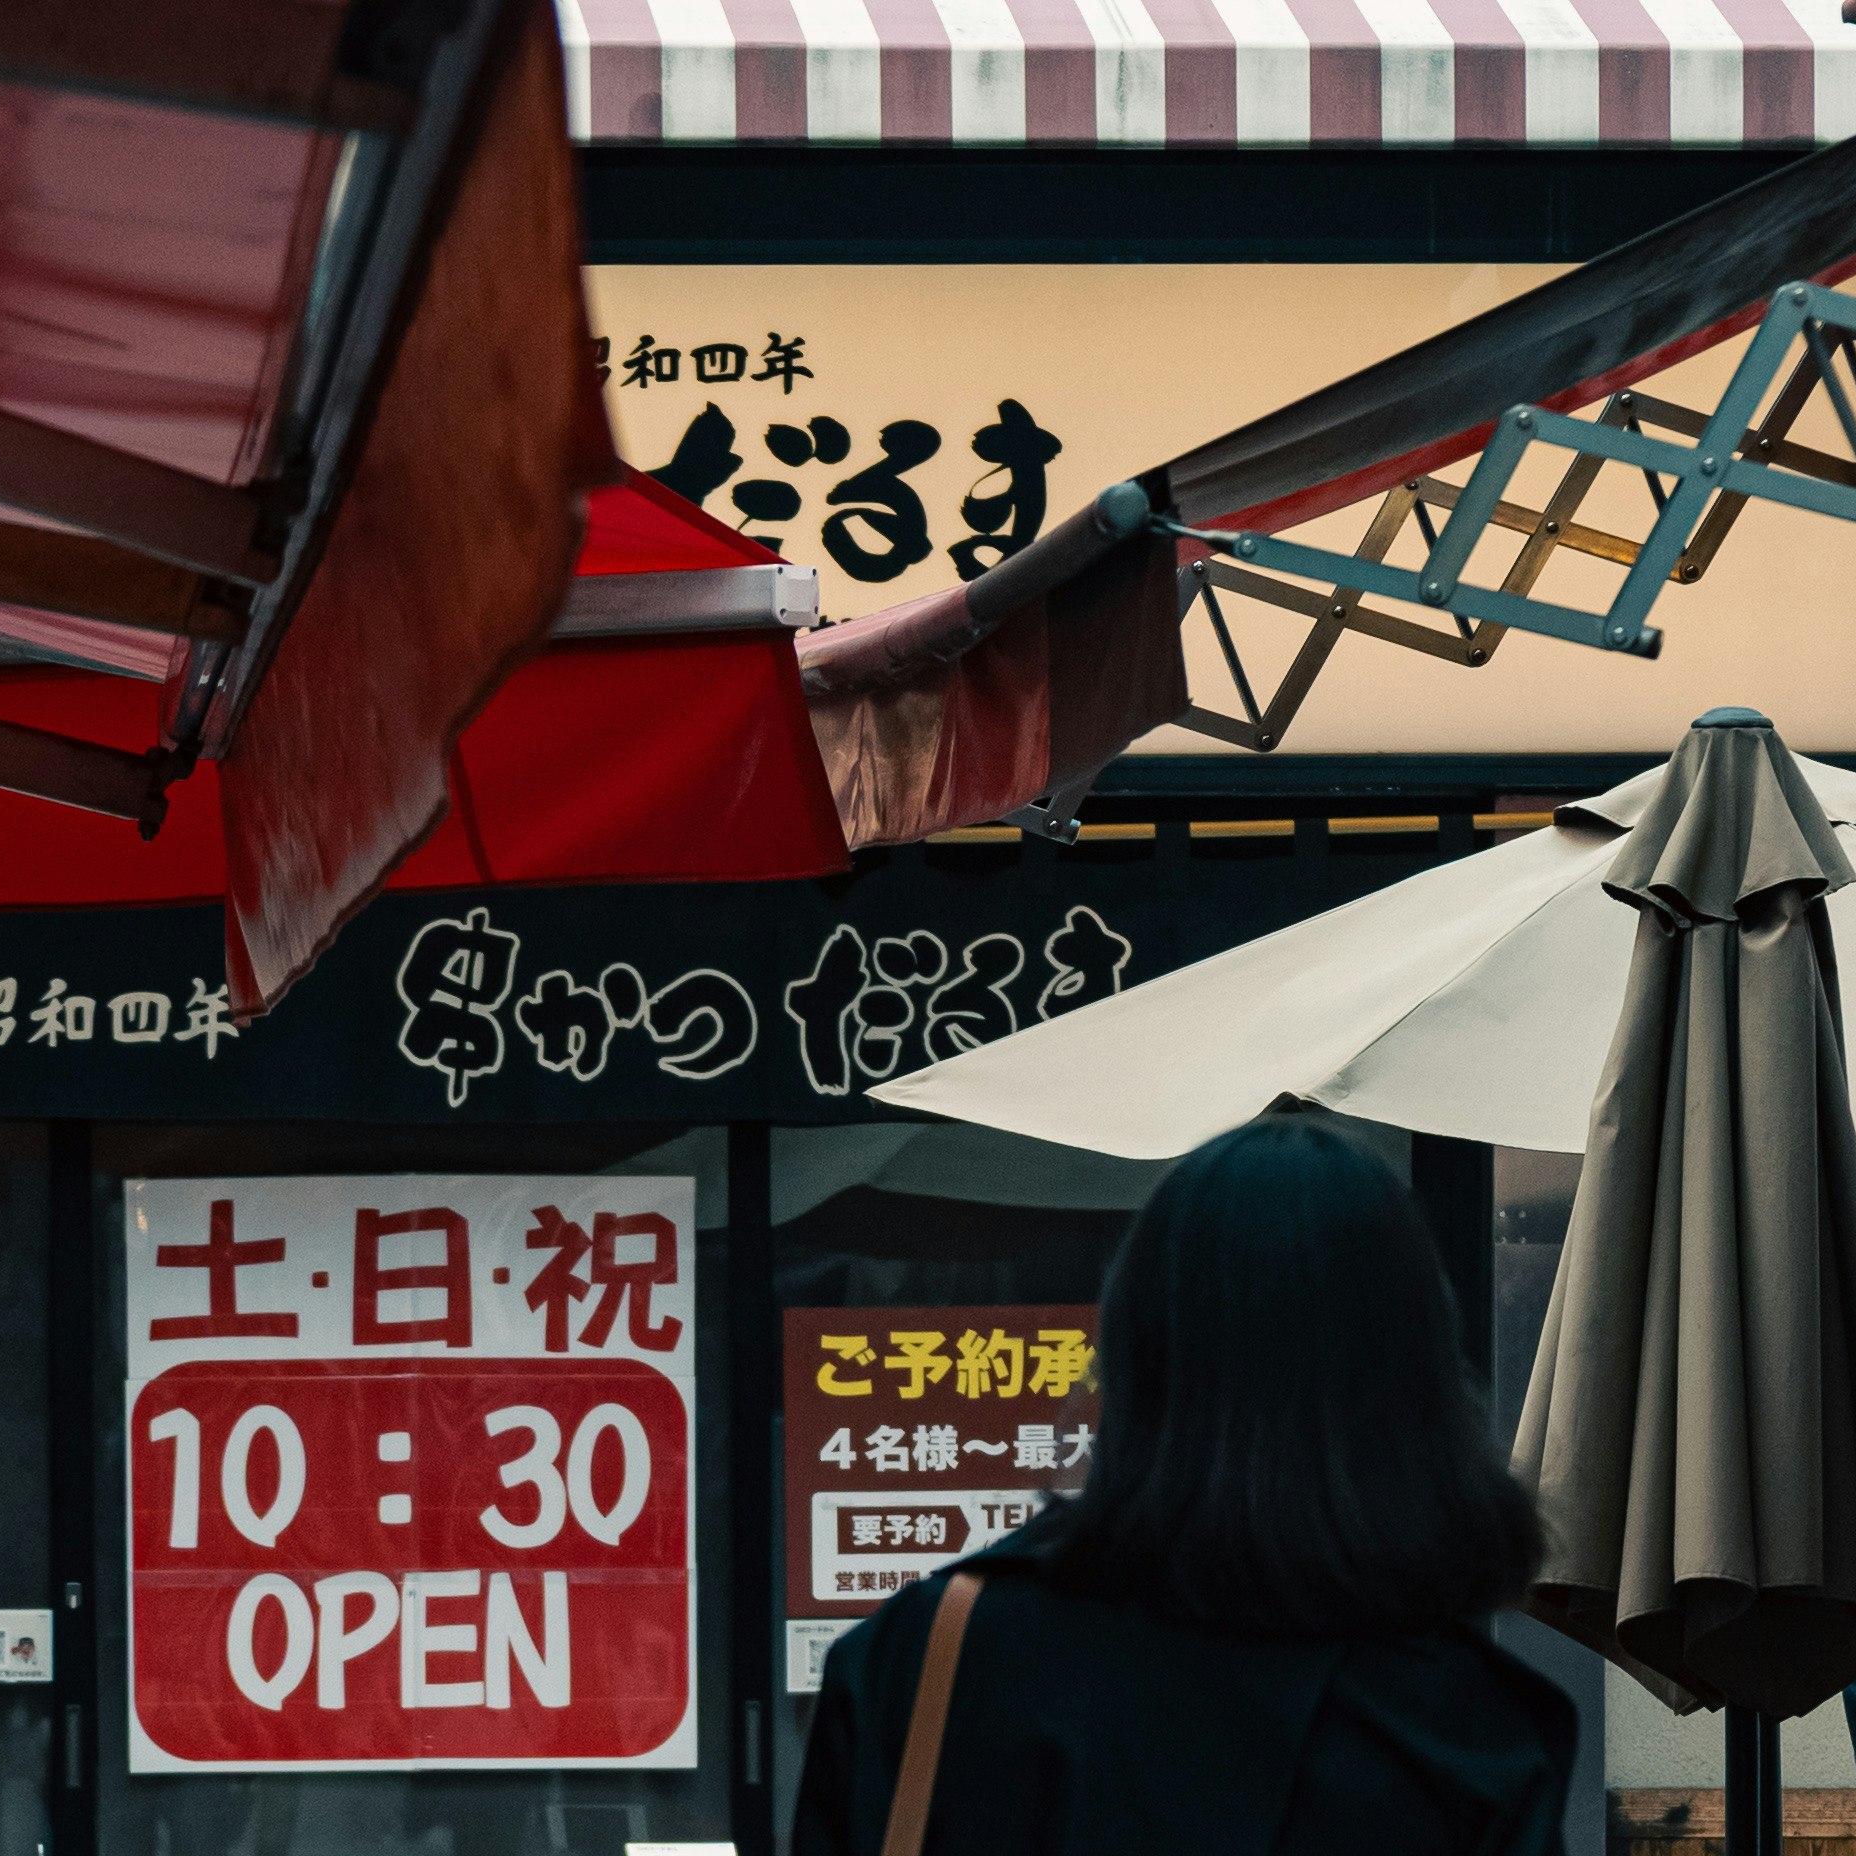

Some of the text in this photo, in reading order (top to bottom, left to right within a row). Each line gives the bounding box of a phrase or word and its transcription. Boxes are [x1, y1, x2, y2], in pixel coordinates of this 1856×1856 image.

[851, 1513, 947, 1546] 要予約
[227, 1569, 571, 1711] OPEN
